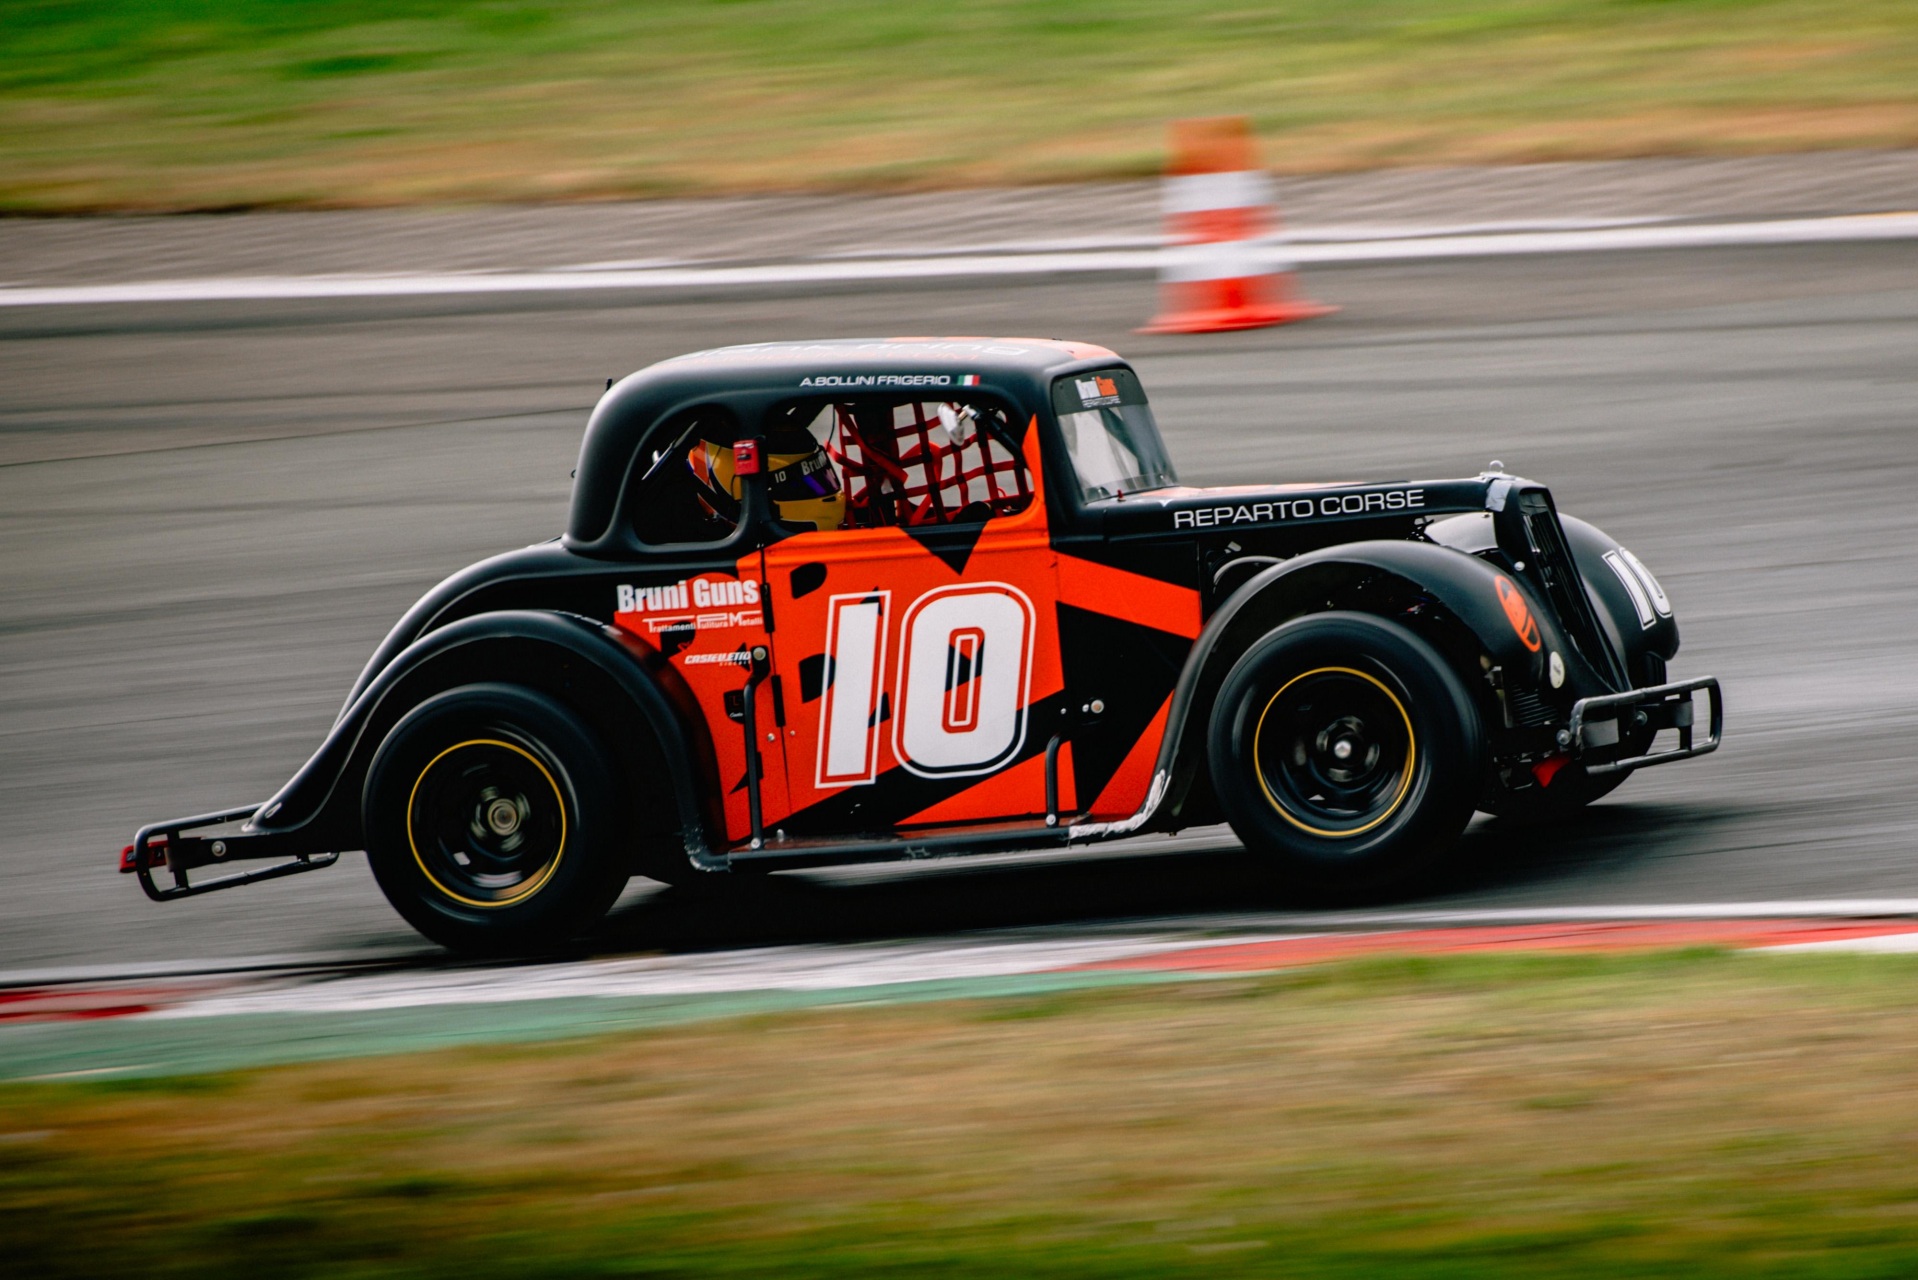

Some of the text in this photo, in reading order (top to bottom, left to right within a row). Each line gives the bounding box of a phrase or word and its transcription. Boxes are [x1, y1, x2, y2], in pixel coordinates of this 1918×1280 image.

[800, 374, 950, 387] A.BOLLINI FRIGERIO
[774, 470, 787, 483] 10
[1173, 488, 1426, 529] REPARTO CORSE
[616, 578, 761, 614] Bruni Guns
[1602, 547, 1673, 631] 10
[814, 580, 1036, 790] 10
